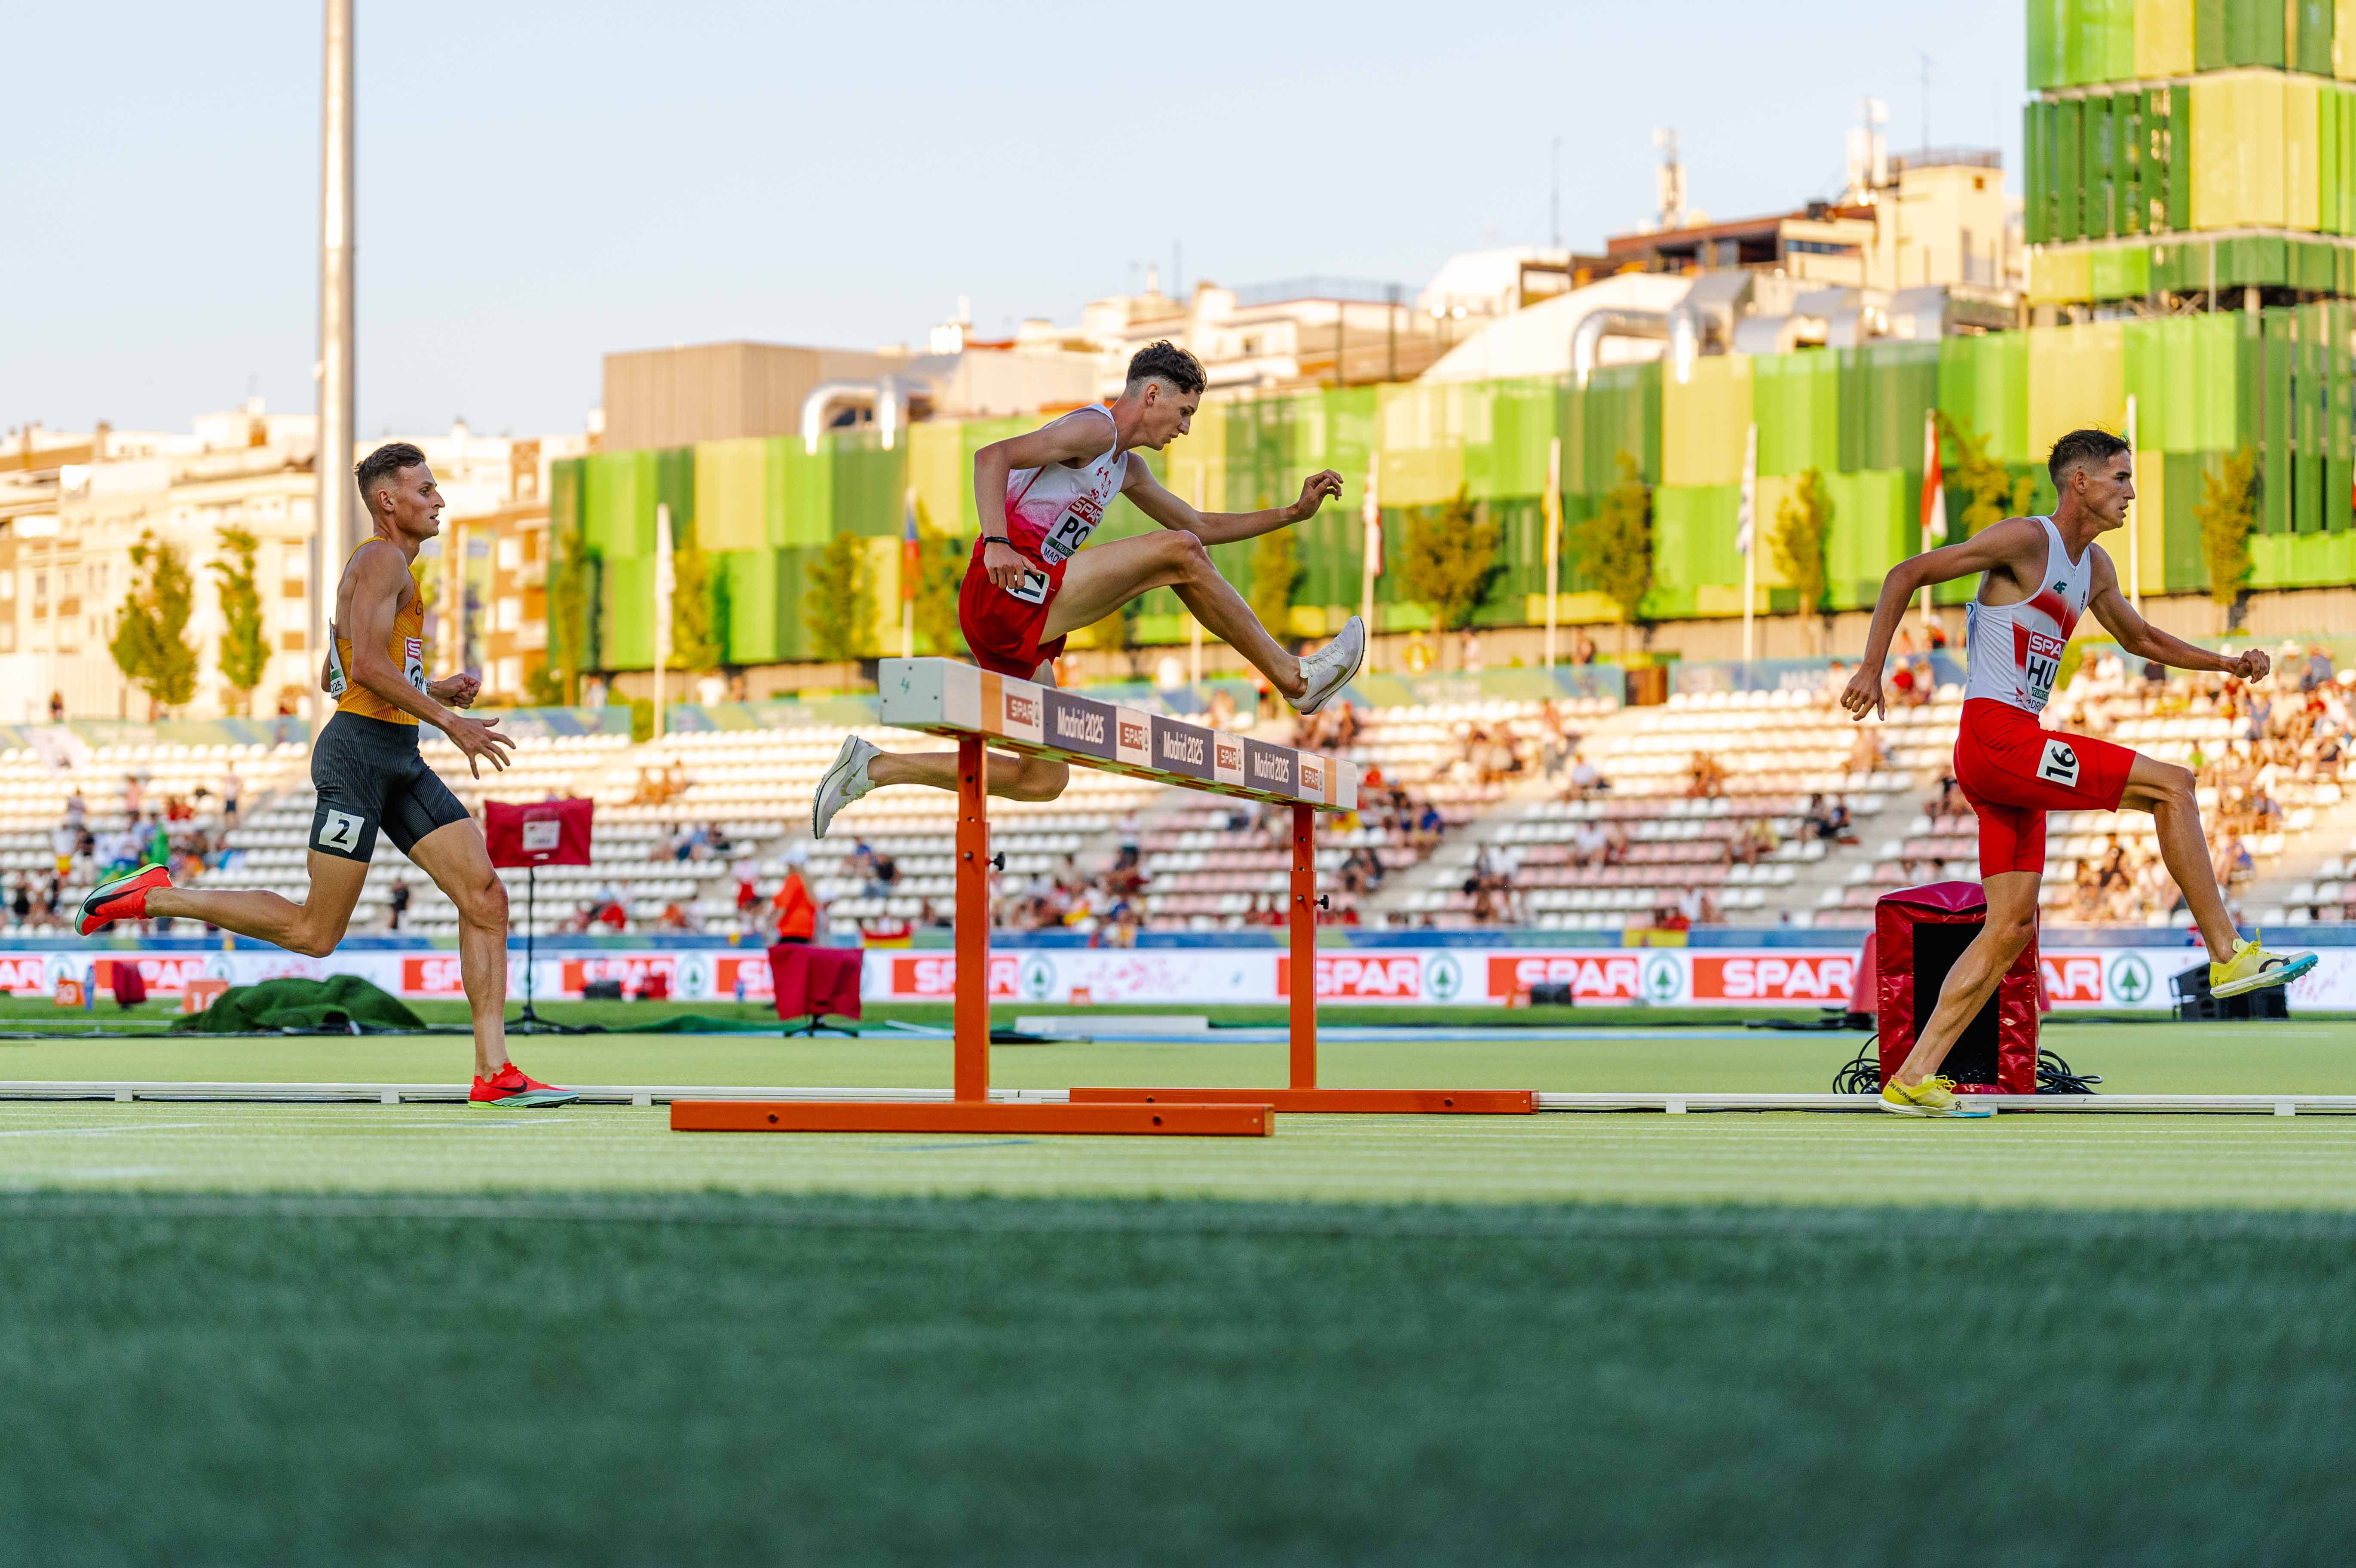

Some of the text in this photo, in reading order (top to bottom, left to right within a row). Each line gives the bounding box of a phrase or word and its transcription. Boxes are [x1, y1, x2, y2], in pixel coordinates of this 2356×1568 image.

[1071, 499, 1100, 523] SPAR
[1056, 516, 1092, 550] PO
[1013, 569, 1045, 598] 12
[2031, 635, 2064, 658] SPA
[1011, 699, 1032, 721] SPAR
[1057, 706, 1104, 744] Madrid 2025
[1124, 727, 1143, 745] SPAR
[1163, 731, 1204, 765] Madrid 2025
[1221, 749, 1237, 766] SPAR
[2046, 746, 2076, 779] 16
[1254, 751, 1290, 783] Madrid 2025
[1305, 769, 1318, 785] SPAR
[331, 819, 350, 845] 2
[0, 959, 43, 989] AR
[138, 960, 203, 989] PAR
[1515, 959, 1639, 997] SPAR
[1722, 959, 1854, 997] SPAR
[2040, 959, 2100, 999] AR
[1895, 1087, 1923, 1106] RUNNING
